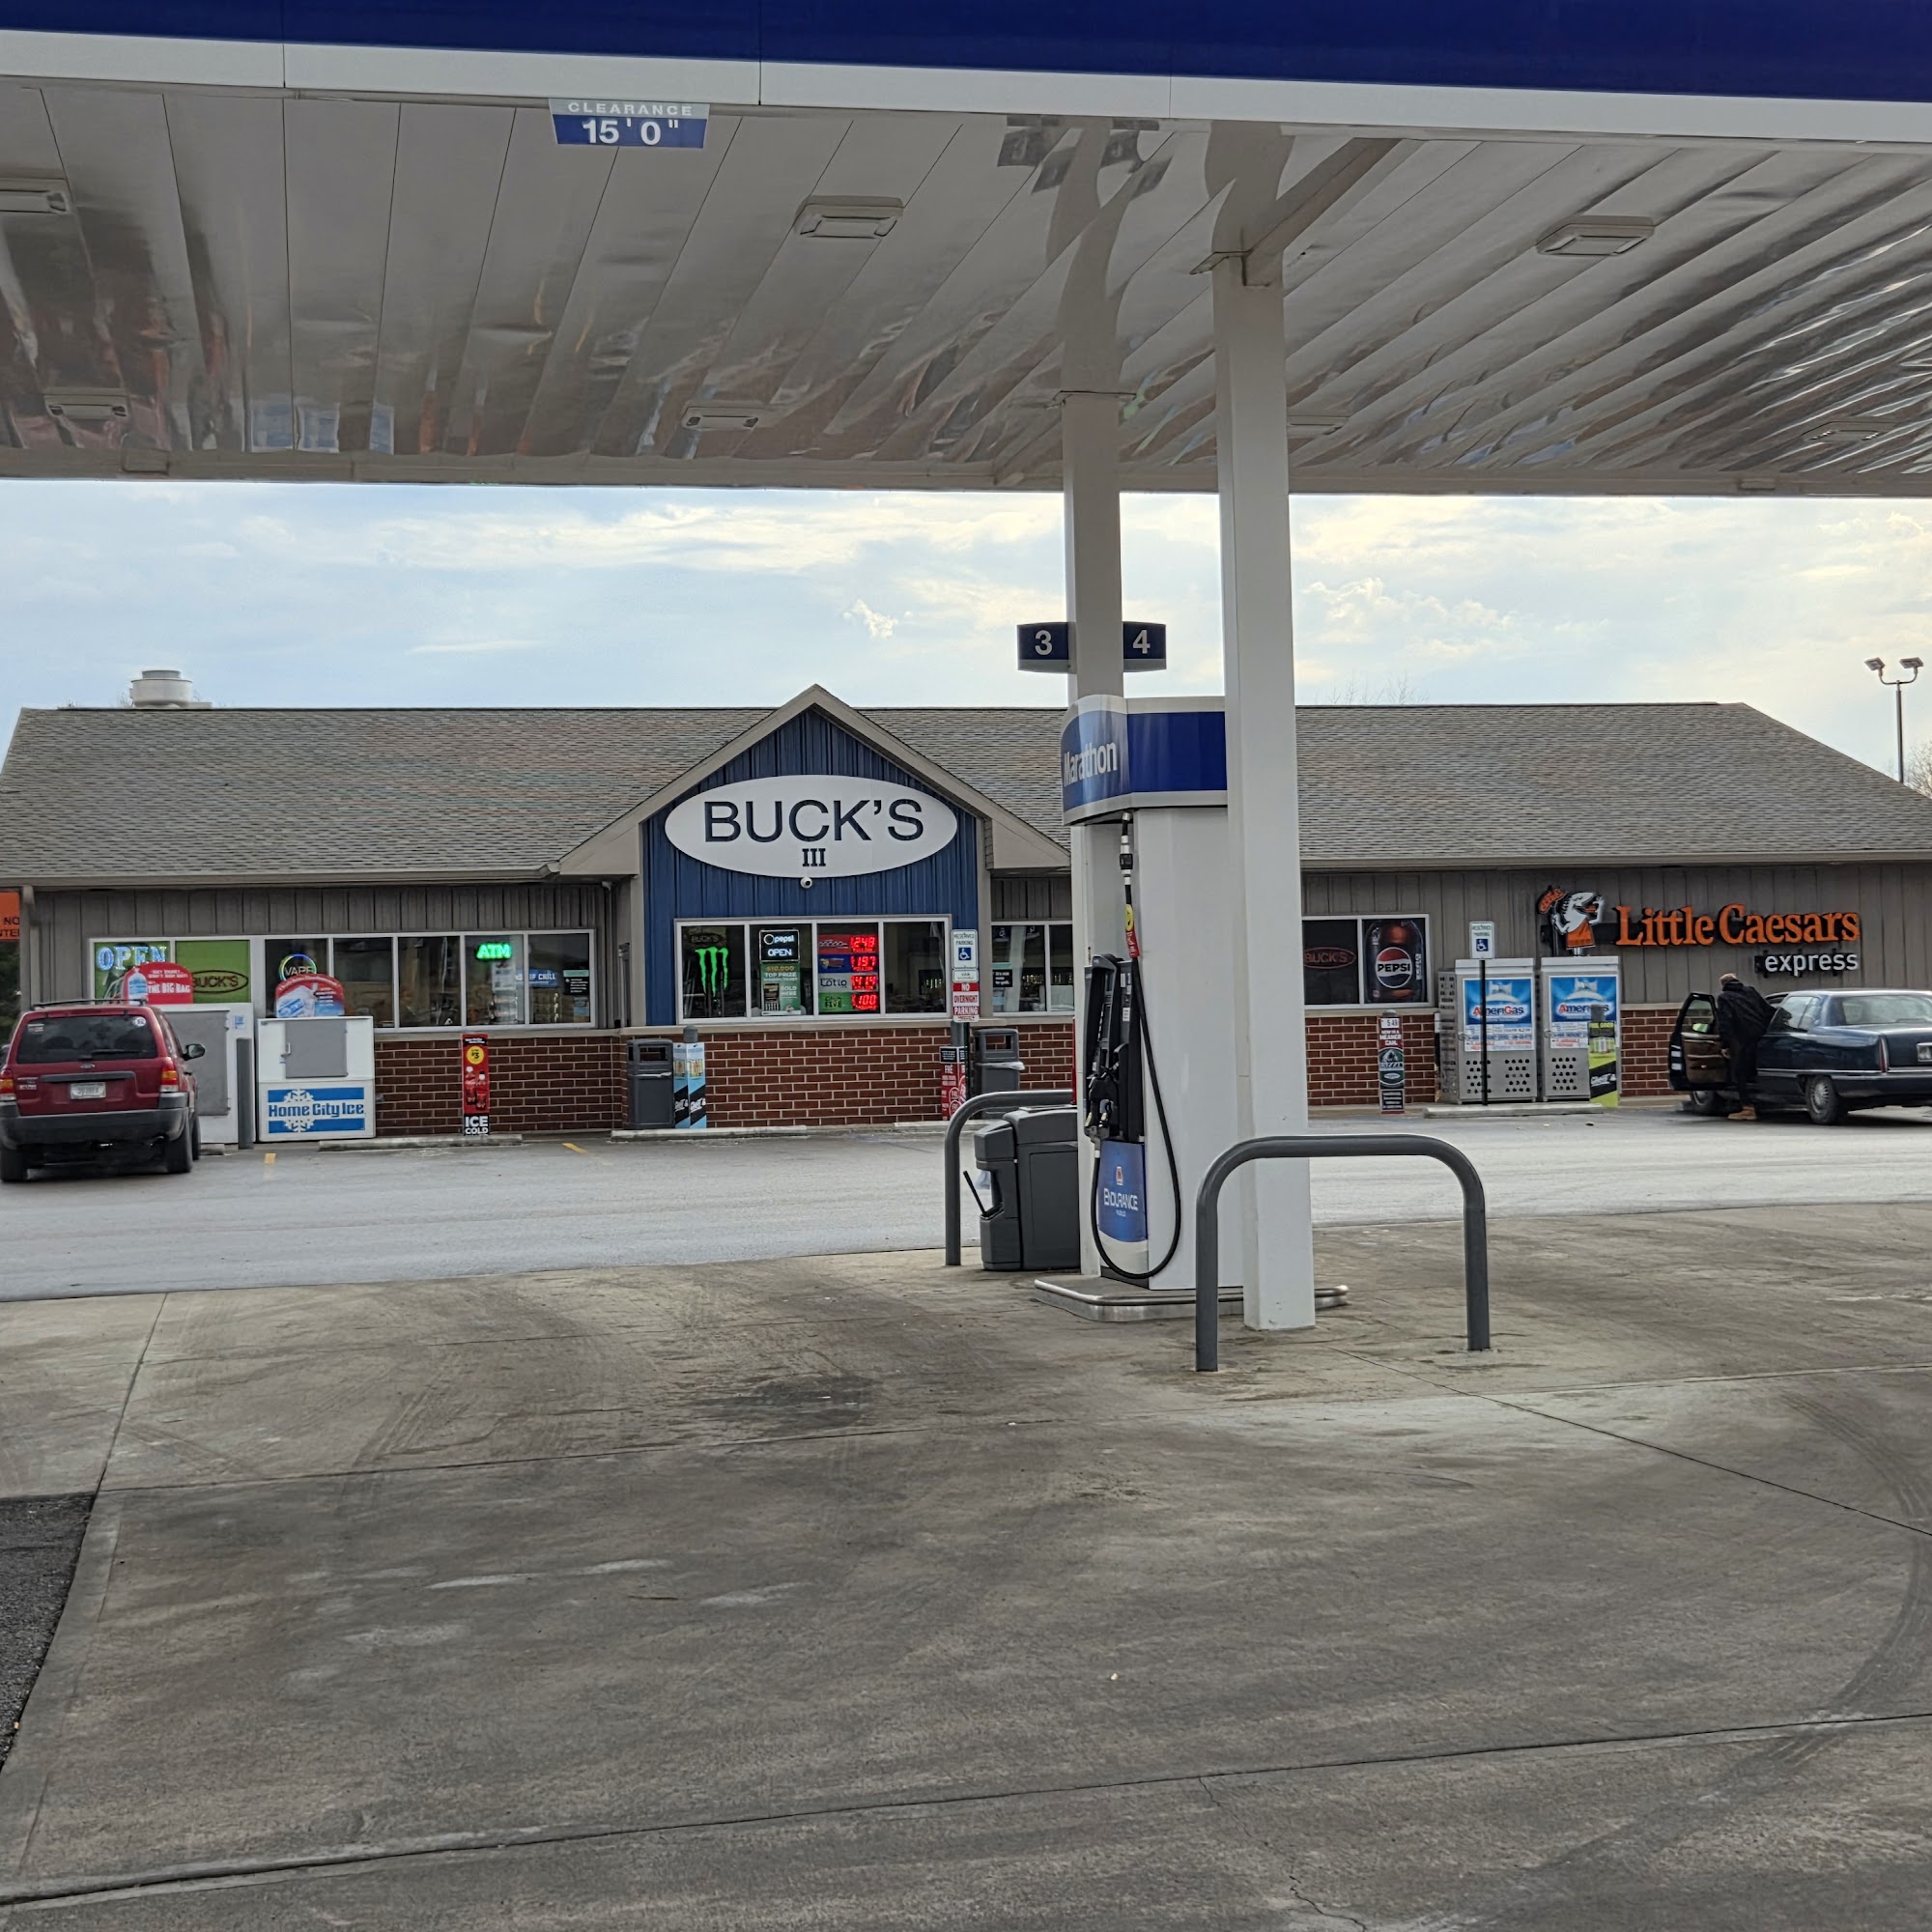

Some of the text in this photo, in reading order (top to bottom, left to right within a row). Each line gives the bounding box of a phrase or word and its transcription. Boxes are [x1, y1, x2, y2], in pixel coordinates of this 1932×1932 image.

[568, 102, 692, 116] CLEARANCE
[1035, 630, 1052, 655] 3
[1132, 630, 1151, 654] 4
[1064, 742, 1117, 786] Marathon
[704, 799, 923, 842] BUCK'S
[802, 848, 826, 867] III
[1616, 903, 1861, 946] Little Caesars
[98, 946, 167, 970] OPEN
[477, 943, 511, 959] ATM
[768, 948, 792, 956] OPEN
[1378, 963, 1410, 973] PEPSI
[1765, 952, 1858, 976] express
[961, 982, 970, 991] NO
[953, 1007, 979, 1015] PARKING
[1559, 1004, 1609, 1014] Ameris
[269, 1102, 364, 1118] Home City Ice
[465, 1116, 488, 1127] ICE
